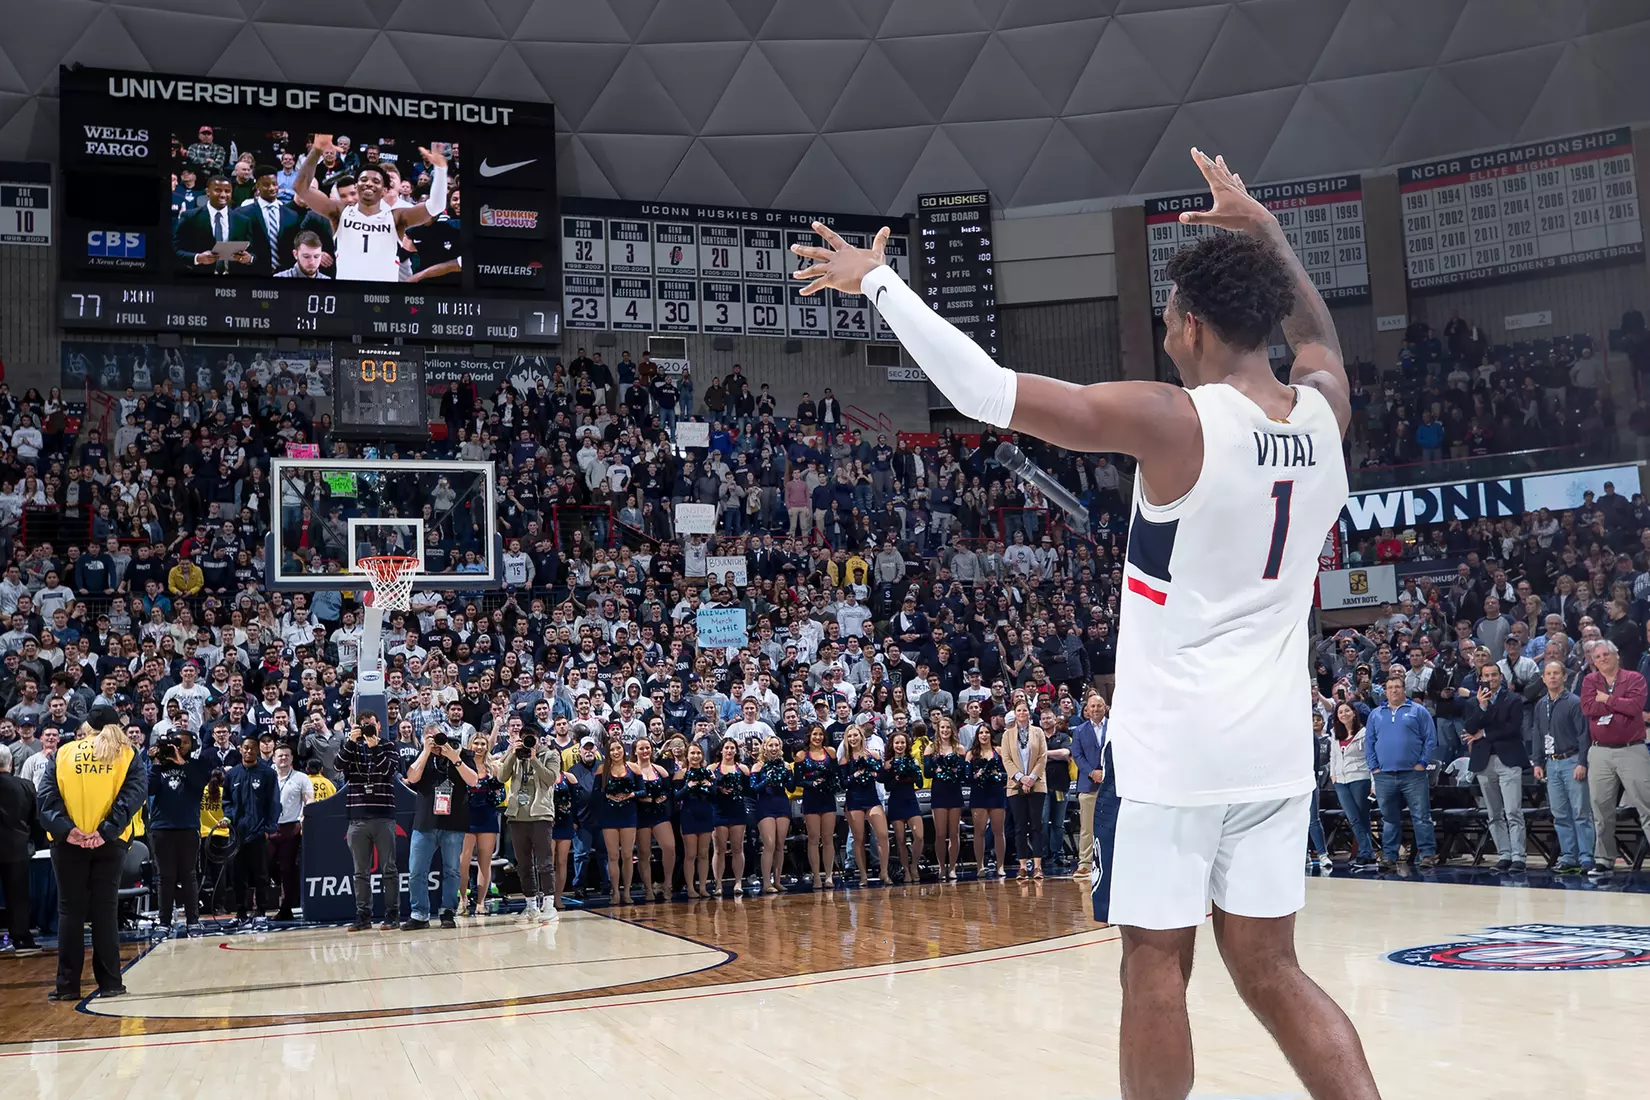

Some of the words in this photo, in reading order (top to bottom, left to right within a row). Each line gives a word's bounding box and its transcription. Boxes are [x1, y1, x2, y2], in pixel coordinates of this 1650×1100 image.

[109, 77, 277, 106] UNIVERSITY
[286, 89, 320, 109] OF
[329, 92, 513, 126] CONNECTICUT
[84, 125, 149, 141] WELLS
[86, 142, 148, 158] FARGO
[1411, 161, 1461, 180] NCAA
[1471, 133, 1617, 168] CHAMPIONSHIP
[1469, 166, 1509, 181] ELITE
[1516, 158, 1558, 172] EIGHT
[1406, 194, 1428, 210] 1991
[1437, 188, 1461, 204] 1994
[1470, 182, 1493, 199] 1995
[1503, 177, 1526, 193] 1996
[1536, 171, 1560, 187] 1997
[1570, 165, 1594, 182] 1998
[1604, 159, 1631, 176] 2000
[921, 197, 936, 207] GO
[939, 194, 987, 205] HUSKIES
[1158, 197, 1204, 211] NCAA
[1249, 179, 1348, 199] MPIONSHIP
[496, 209, 538, 219] DUNKIN'
[642, 205, 690, 216] UCONN
[698, 208, 758, 221] HUSKIES
[766, 213, 782, 222] OF
[790, 214, 835, 225] HONOR
[1407, 215, 1431, 231] 2001
[1439, 210, 1464, 227] 2002
[1471, 204, 1497, 220] 2003
[1504, 199, 1530, 215] 2004
[1537, 192, 1564, 209] 2006
[1572, 186, 1597, 203] 2007
[1605, 181, 1633, 198] 2008
[16, 210, 34, 233] 10
[344, 218, 391, 234] UCONN
[496, 218, 537, 229] DONUTS
[930, 213, 949, 223] STAT
[951, 211, 979, 222] BOARD
[1152, 226, 1173, 241] 1991
[1304, 209, 1327, 223] 1998
[1335, 204, 1359, 219] 1999
[1305, 230, 1329, 244] 2005
[1336, 226, 1361, 241] 2006
[1409, 237, 1434, 253] 2009
[1441, 231, 1466, 248] 2010
[1474, 226, 1498, 242] 2011
[1507, 220, 1531, 237] 2012
[1541, 215, 1565, 231] 2013
[1574, 209, 1600, 226] 2014
[1608, 203, 1634, 220] 2015
[361, 234, 369, 253] 1
[575, 240, 593, 261] 32
[925, 241, 935, 250] 50
[949, 240, 963, 248] FG%
[626, 243, 634, 264] 3
[712, 248, 729, 268] 20
[756, 250, 771, 271] 31
[926, 256, 936, 265] 75
[1308, 251, 1330, 265] 2012
[1339, 247, 1362, 262] 2013
[1411, 258, 1435, 274] 2016
[1443, 253, 1467, 269] 2017
[1476, 247, 1500, 264] 2018
[1509, 242, 1534, 259] 2019
[116, 259, 146, 268] Company
[477, 264, 532, 276] TRAVELERS
[1411, 268, 1493, 288] CONNECTICUT
[1498, 258, 1555, 274] WOMEN'S
[1560, 244, 1642, 265] BASKETBALL
[946, 271, 951, 279] 3
[215, 288, 236, 298] POSS
[252, 290, 279, 300] BONUS
[364, 294, 390, 304] BONUS
[404, 296, 424, 305] POSS
[928, 287, 938, 296] 32
[942, 285, 977, 294] REBOUNDS
[71, 293, 101, 318] 77
[571, 297, 598, 320] 23
[625, 300, 638, 321] 4
[664, 301, 690, 323] 30
[716, 303, 729, 324] 3
[933, 302, 939, 310] 8
[946, 300, 973, 309] ASSISTS
[122, 313, 146, 324] FULL
[172, 314, 185, 326] 30
[188, 315, 208, 327] SEC
[225, 316, 233, 328] 9
[235, 316, 250, 328] TM
[253, 317, 270, 329] FLS
[533, 311, 559, 334] 71
[753, 305, 778, 327] CD
[799, 307, 817, 328] 15
[836, 309, 865, 330] 24
[373, 321, 388, 332] TM
[390, 322, 406, 333] FLS
[431, 323, 444, 334] 30
[446, 324, 464, 335] SEC
[465, 324, 473, 336] 0
[487, 325, 508, 337] FULL
[426, 359, 451, 369] vilion
[460, 361, 491, 371] Storrs,
[493, 362, 506, 370] CT
[1253, 431, 1316, 467] VITAL
[1261, 480, 1294, 580] 1
[1342, 597, 1361, 605] ARMY
[1361, 595, 1378, 604] ROTC
[75, 764, 114, 775] STAFF
[305, 871, 441, 897] TRAEES
